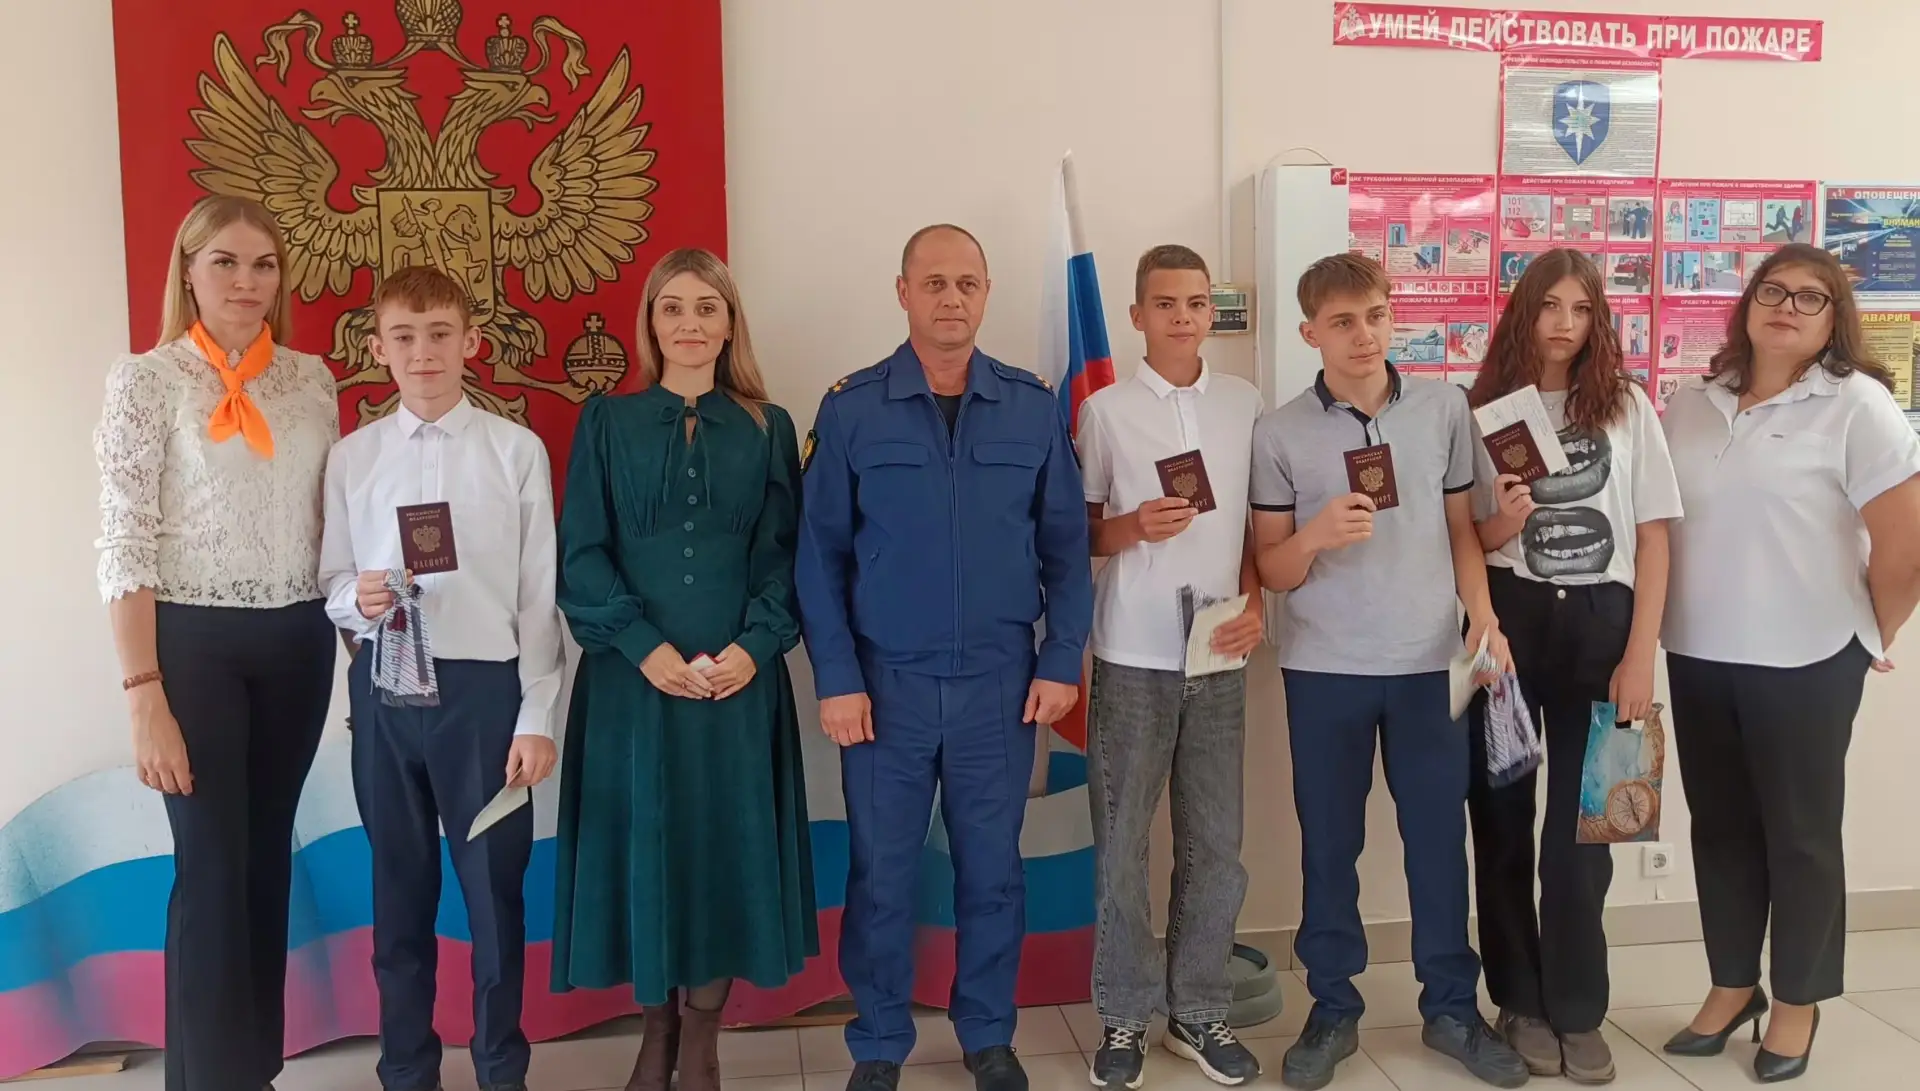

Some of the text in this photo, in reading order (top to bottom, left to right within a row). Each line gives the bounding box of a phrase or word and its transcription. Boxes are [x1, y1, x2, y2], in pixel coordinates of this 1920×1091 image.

[1368, 8, 1812, 53] УМЕЙ ДЕЙСТВОВАТЬ ПРИ ПОЖАРЕ
[1507, 197, 1521, 205] 101
[1507, 207, 1521, 215] 112
[1862, 313, 1911, 322] АВАРИЯ
[1523, 466, 1540, 479] ПОРТ
[1374, 494, 1391, 505] ПОРТ
[413, 556, 449, 569] ПАСПОРТ
